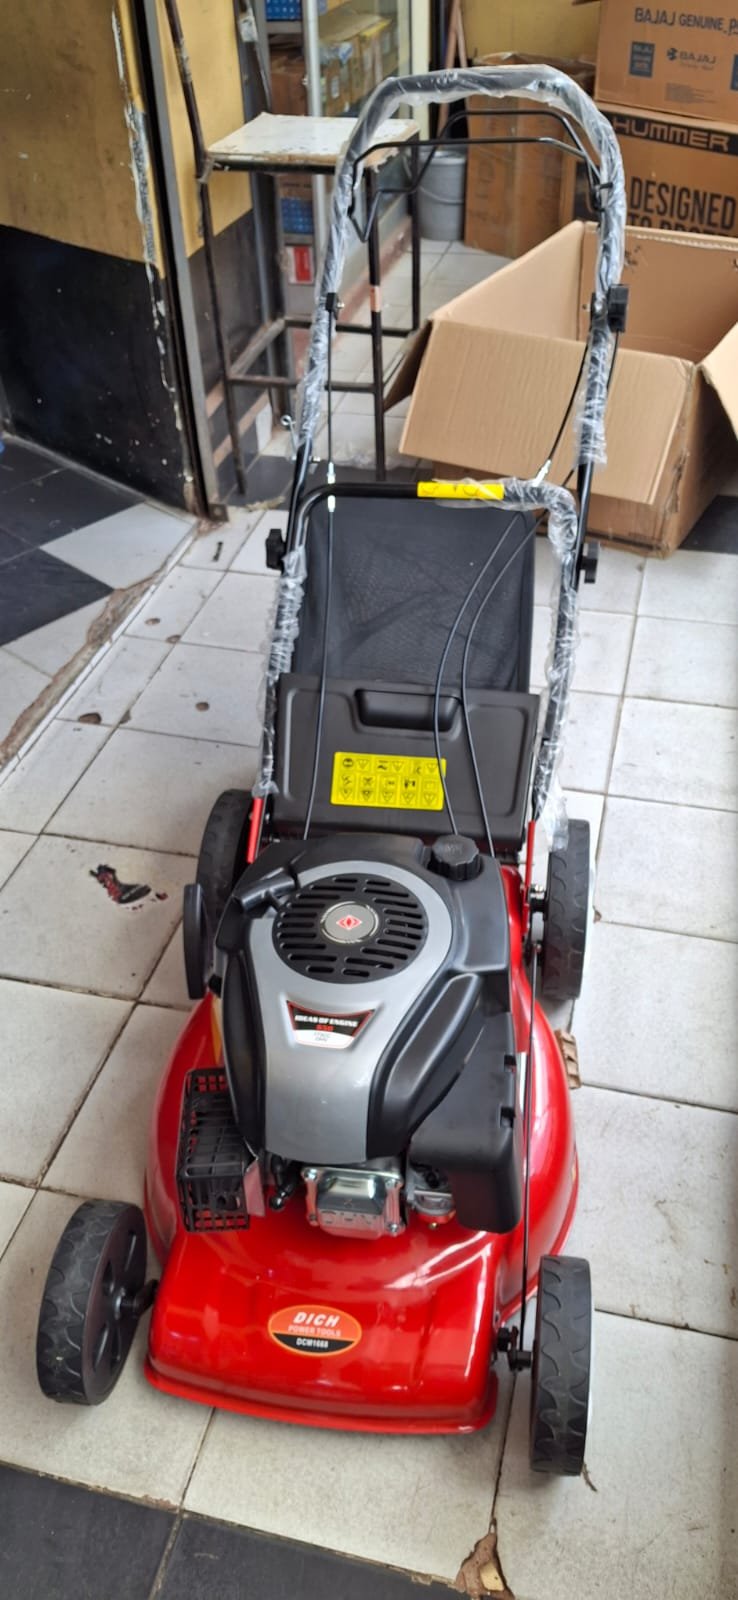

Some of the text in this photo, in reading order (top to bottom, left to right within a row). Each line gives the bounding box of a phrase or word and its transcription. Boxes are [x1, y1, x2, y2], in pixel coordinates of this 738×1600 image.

[634, 7, 676, 26] BAJAJ
[679, 13, 724, 31] GENUINE
[680, 50, 717, 64] BAJAJ
[613, 116, 729, 152] HUMMER
[630, 176, 736, 230] DESIGNED
[293, 1312, 340, 1327] DICH
[288, 1325, 341, 1337] POWER TOOLS
